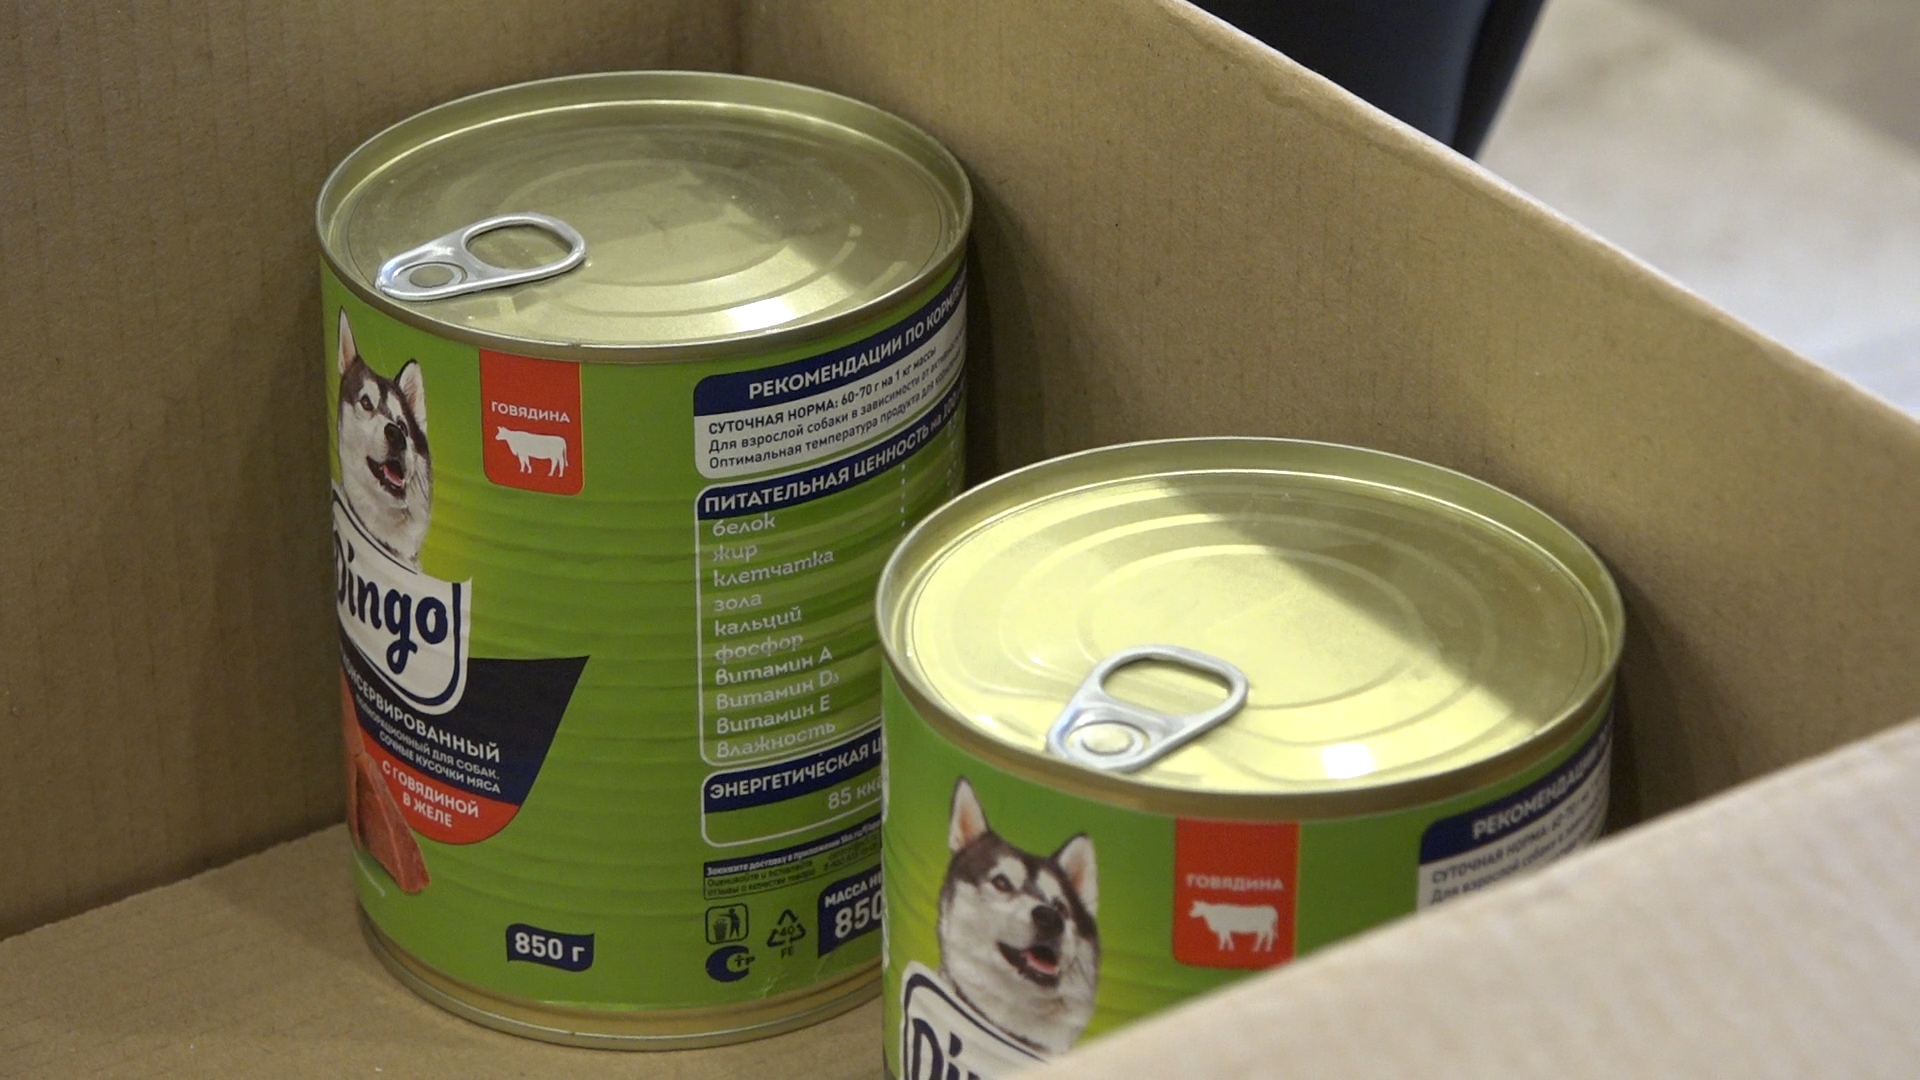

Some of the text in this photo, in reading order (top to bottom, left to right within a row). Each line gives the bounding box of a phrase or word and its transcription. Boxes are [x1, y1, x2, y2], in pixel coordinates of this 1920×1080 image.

[749, 335, 902, 399] РЕКОМЕНДАЦИИ
[905, 322, 924, 346] ПО
[708, 412, 784, 435] СУТОЧНАЯ
[788, 399, 839, 420] НОРМА:
[841, 384, 873, 405] 60-70
[874, 382, 880, 392] г
[881, 375, 893, 389] на
[895, 369, 900, 381] 1
[902, 364, 912, 377] кг
[913, 346, 936, 370] массы
[491, 401, 571, 423] ГОВЯДИНА
[708, 439, 737, 454] Для
[741, 425, 804, 448] взрослой
[807, 412, 849, 434] собаки
[851, 409, 858, 419] в
[860, 376, 921, 416] зависимости
[709, 443, 801, 470] Оптимальная
[805, 417, 878, 452] температура
[880, 392, 920, 425] продукта
[704, 466, 850, 513] ПИТАТЕЛЬНАЯ
[854, 424, 929, 478] ЦЕННОСТЬ
[712, 512, 776, 537] белок
[713, 544, 758, 562] жир
[713, 550, 835, 587] клетчатка
[714, 593, 762, 612] зола
[714, 605, 802, 637] кальций
[715, 633, 804, 665] фосфор
[715, 655, 814, 686] Витамин
[716, 679, 814, 711] Витамин
[716, 704, 815, 735] Витамин
[716, 722, 836, 759] Влажность
[379, 730, 501, 794] СОЧНЫЕ КУСОЧКИ МЯСА
[432, 749, 455, 766] ДЛЯ
[456, 758, 500, 780] СОБАК.
[709, 744, 869, 799] ЭНЕРГЕТИЧЕСКАЯ
[382, 760, 479, 818] С ГОВЯДИНОЙ
[828, 787, 853, 810] 85
[402, 791, 452, 828] В ЖЕЛЕ
[824, 879, 868, 908] МАССА
[1185, 872, 1285, 892] ГОВЯДИНА
[834, 891, 884, 939] 850
[514, 931, 586, 963] 850 г
